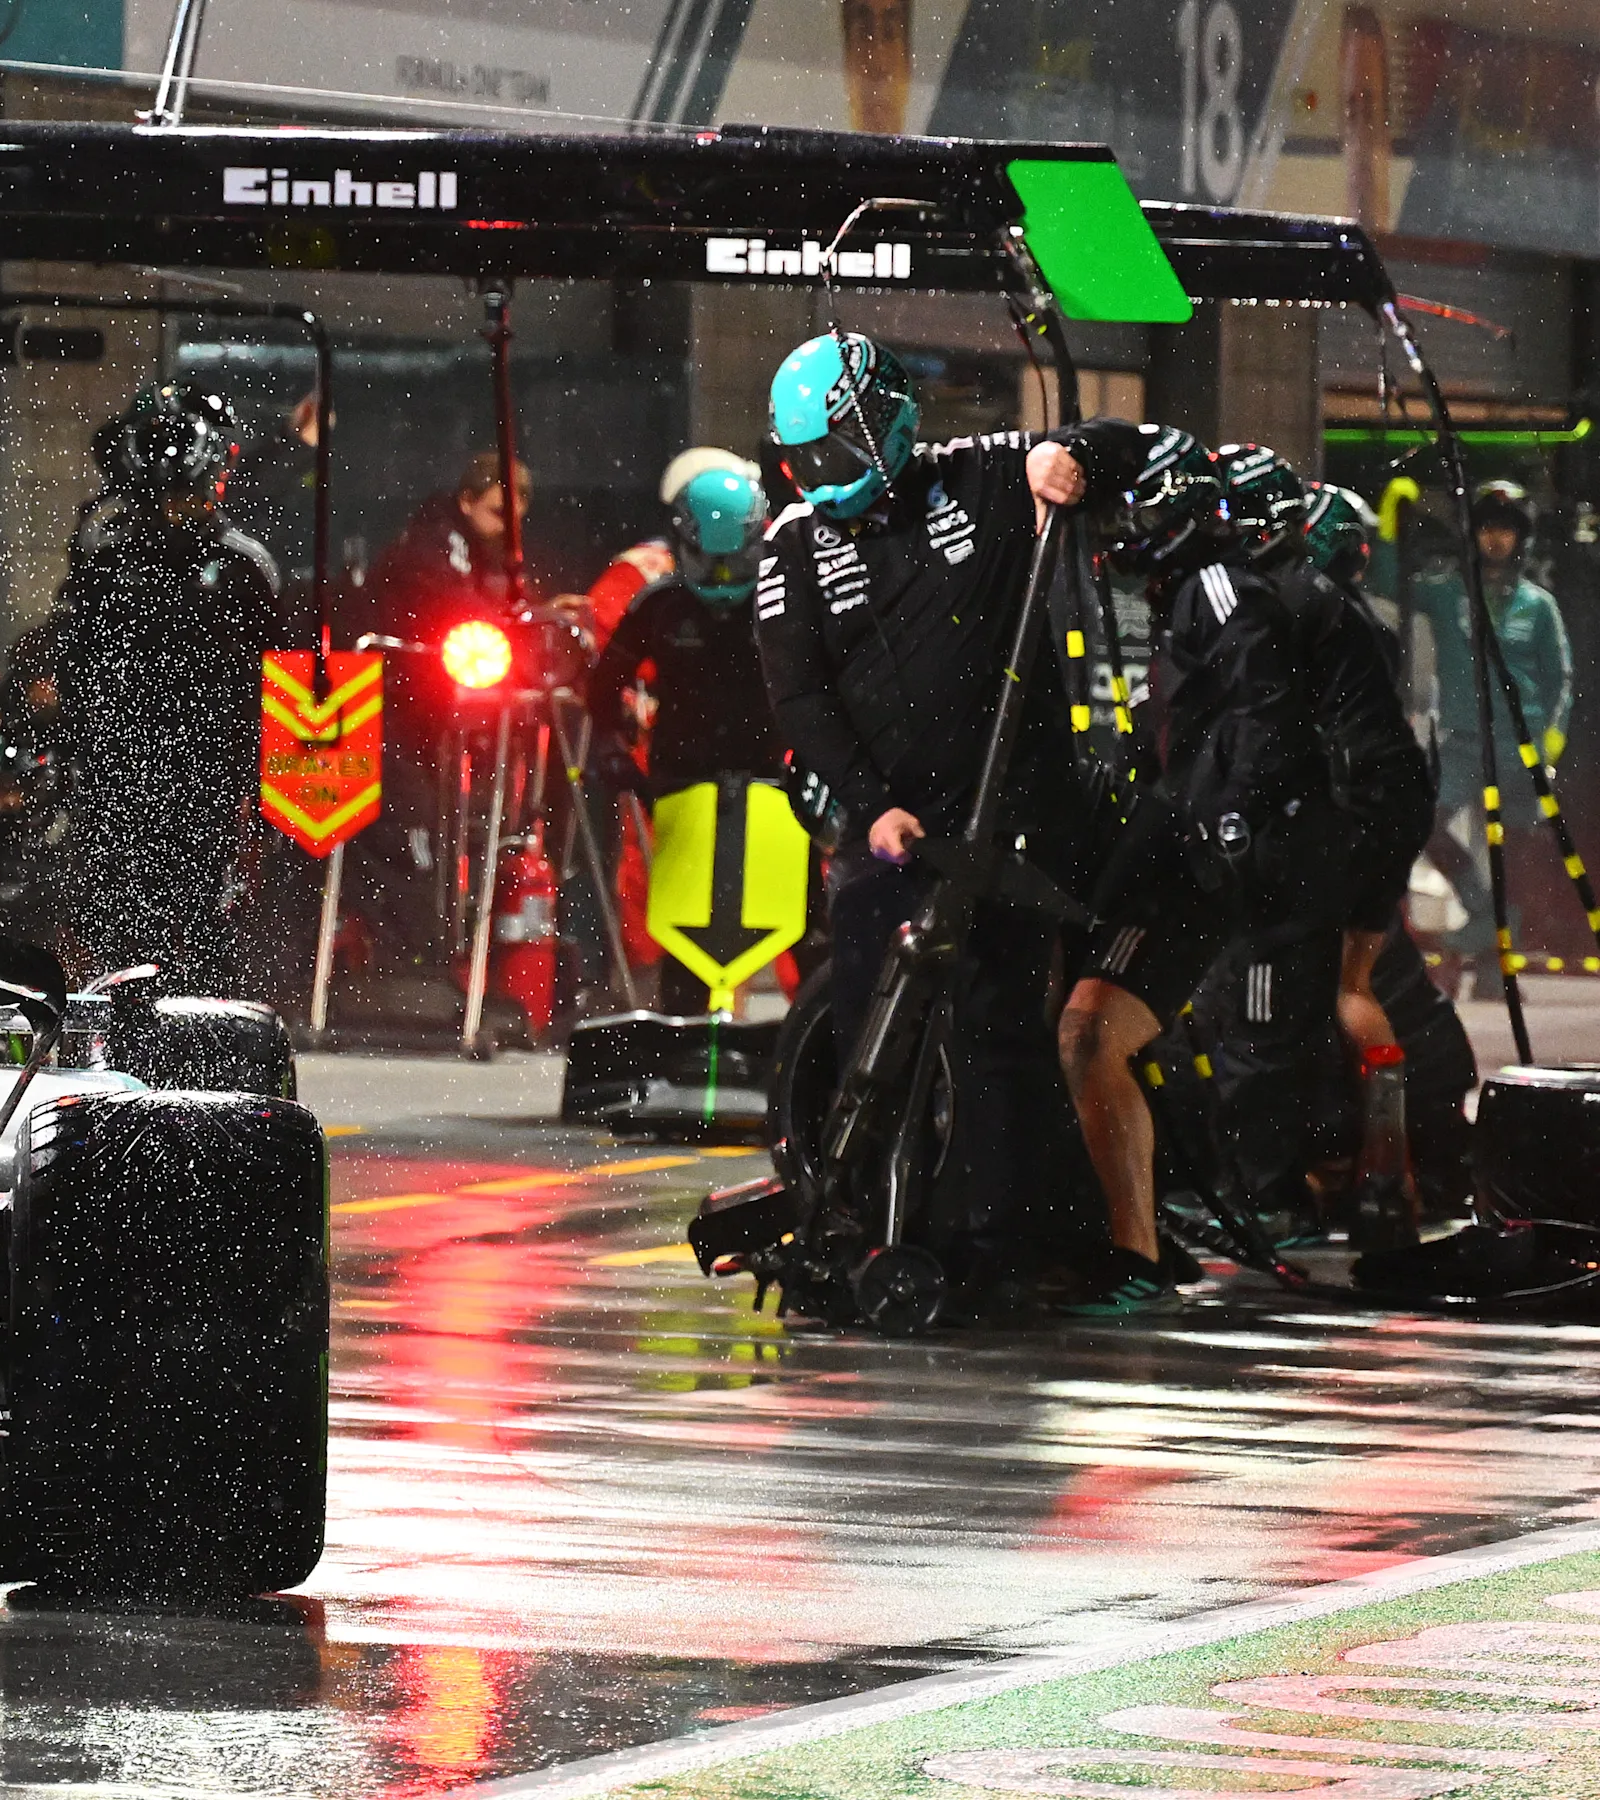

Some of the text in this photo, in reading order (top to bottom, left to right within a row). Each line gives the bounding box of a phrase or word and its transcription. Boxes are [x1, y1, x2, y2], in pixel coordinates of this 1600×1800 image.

[1177, 0, 1244, 202] 18
[223, 166, 458, 210] Einhell
[706, 237, 912, 280] Einhell
